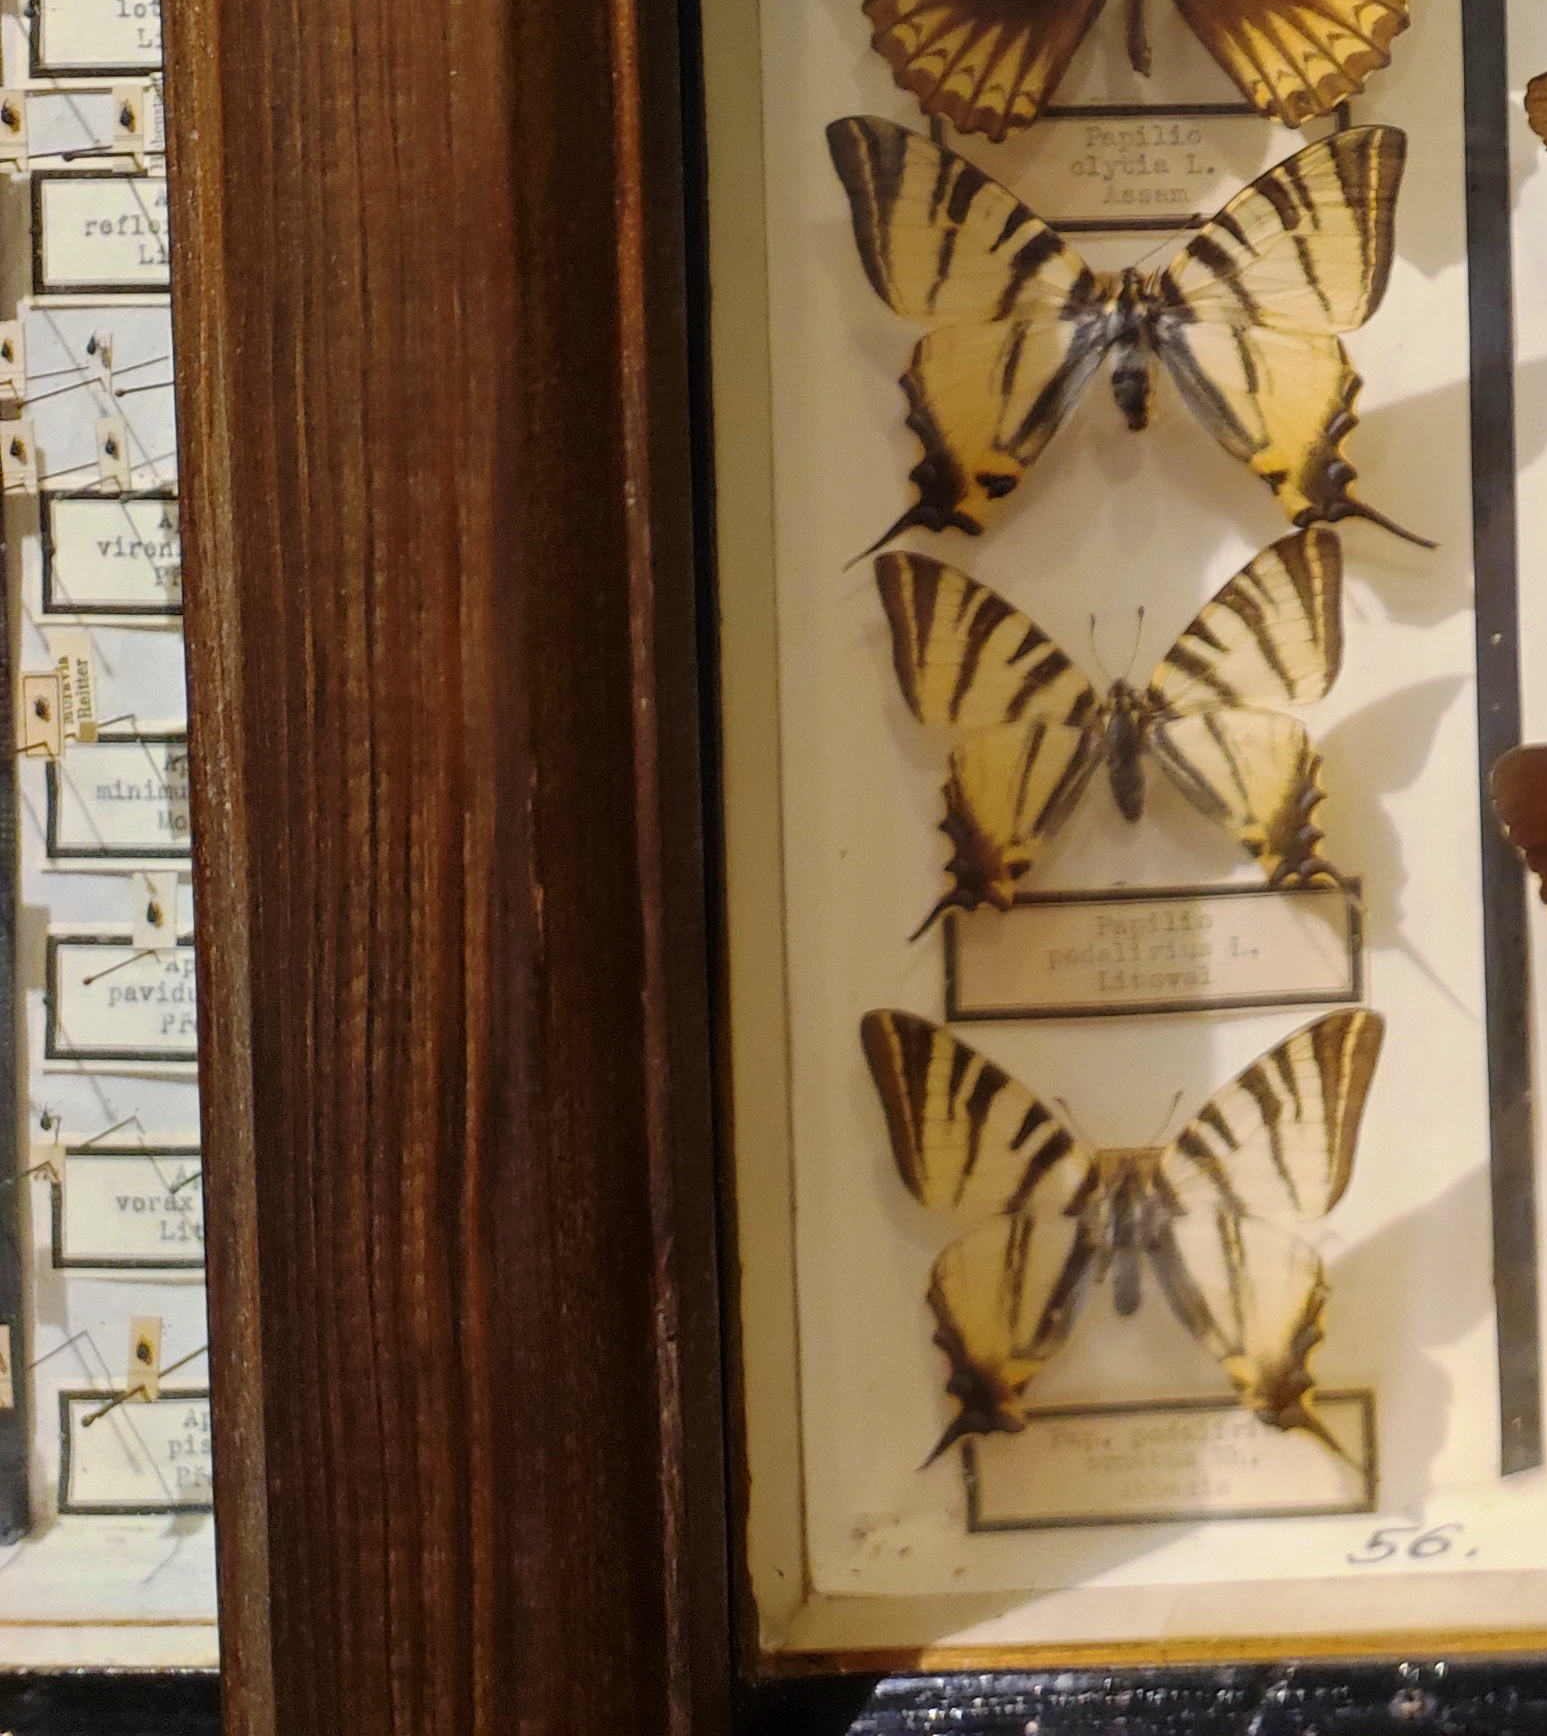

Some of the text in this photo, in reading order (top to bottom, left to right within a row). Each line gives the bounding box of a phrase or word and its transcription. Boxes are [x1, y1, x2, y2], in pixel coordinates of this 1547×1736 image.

[1083, 125, 1203, 154] Papilio
[1184, 153, 1216, 177] L.
[1102, 182, 1190, 205] Assam
[84, 214, 168, 237] refle
[97, 536, 182, 558] viren
[1095, 911, 1214, 940] Papilio
[1228, 936, 1261, 961] L.
[115, 1194, 194, 1213] vorax
